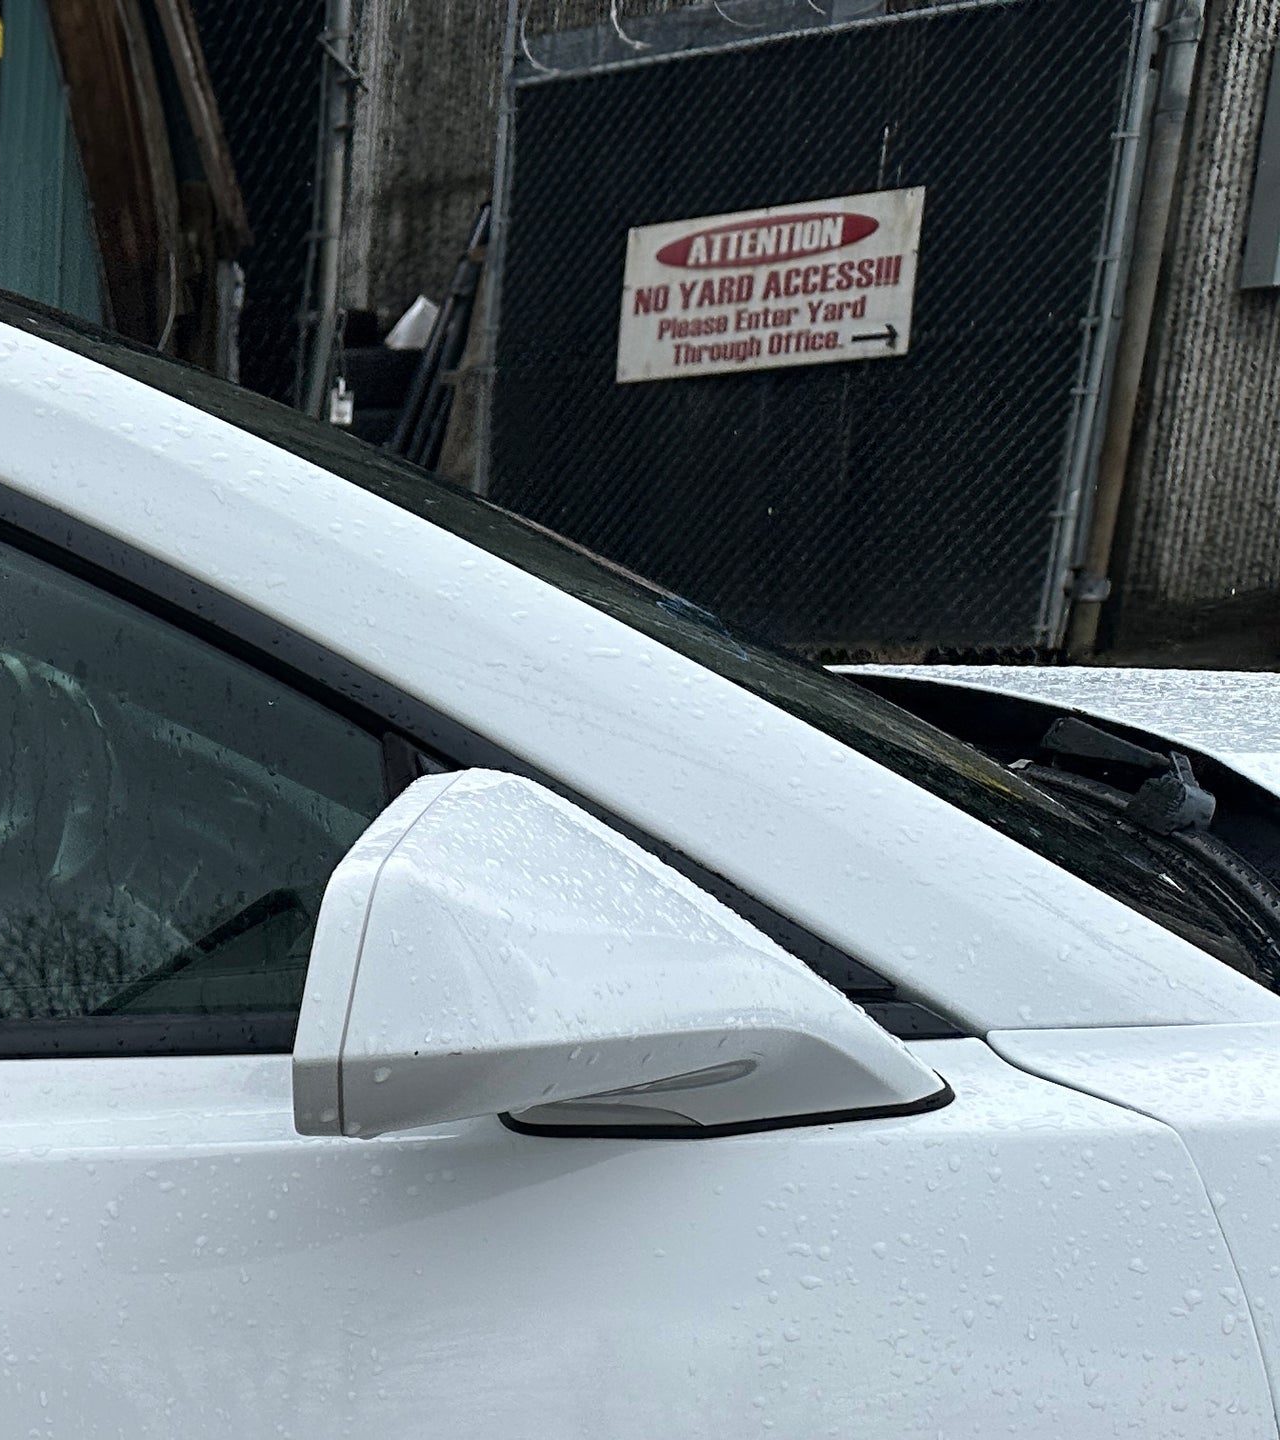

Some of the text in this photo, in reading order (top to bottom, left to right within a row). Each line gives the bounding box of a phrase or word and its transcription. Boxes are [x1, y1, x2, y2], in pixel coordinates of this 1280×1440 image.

[686, 217, 844, 265] ATTENTION
[634, 255, 903, 316] NO YARD ACCESS!!!
[657, 296, 867, 340] Please Enter Yard
[672, 334, 762, 367] Through
